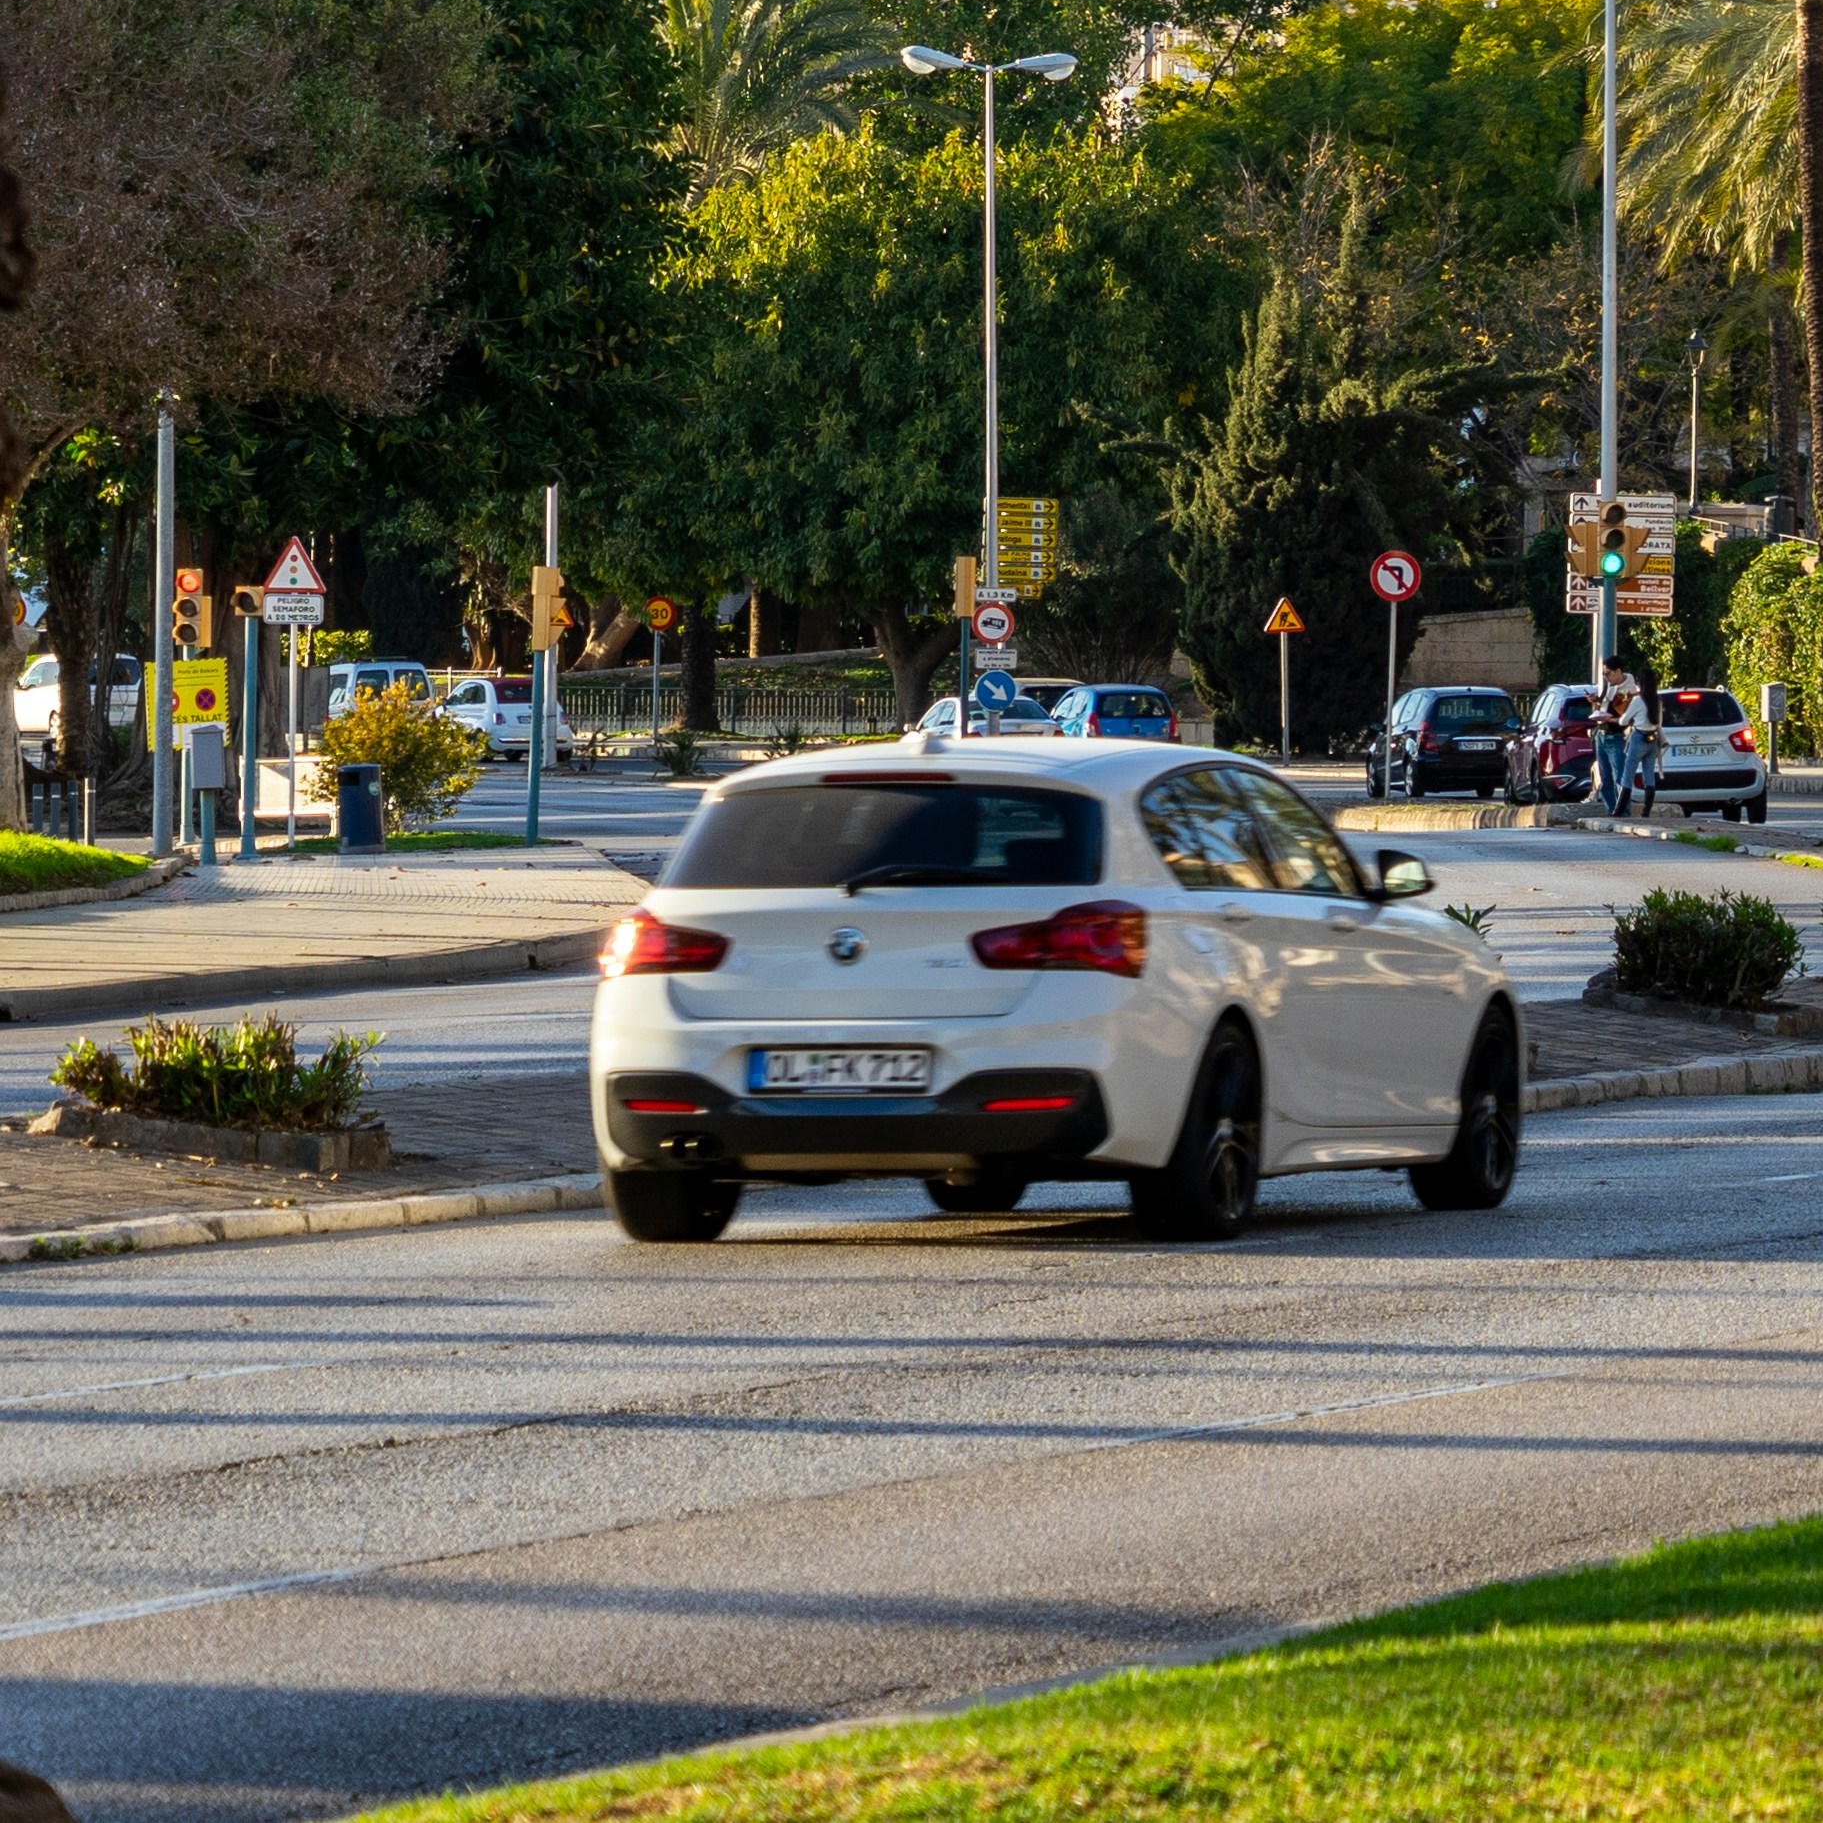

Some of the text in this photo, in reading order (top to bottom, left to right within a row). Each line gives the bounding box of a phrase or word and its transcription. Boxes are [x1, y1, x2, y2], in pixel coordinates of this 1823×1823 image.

[1641, 585, 1671, 593] Bellver
[651, 608, 669, 620] 30
[172, 713, 223, 724] CÉS TALLAT
